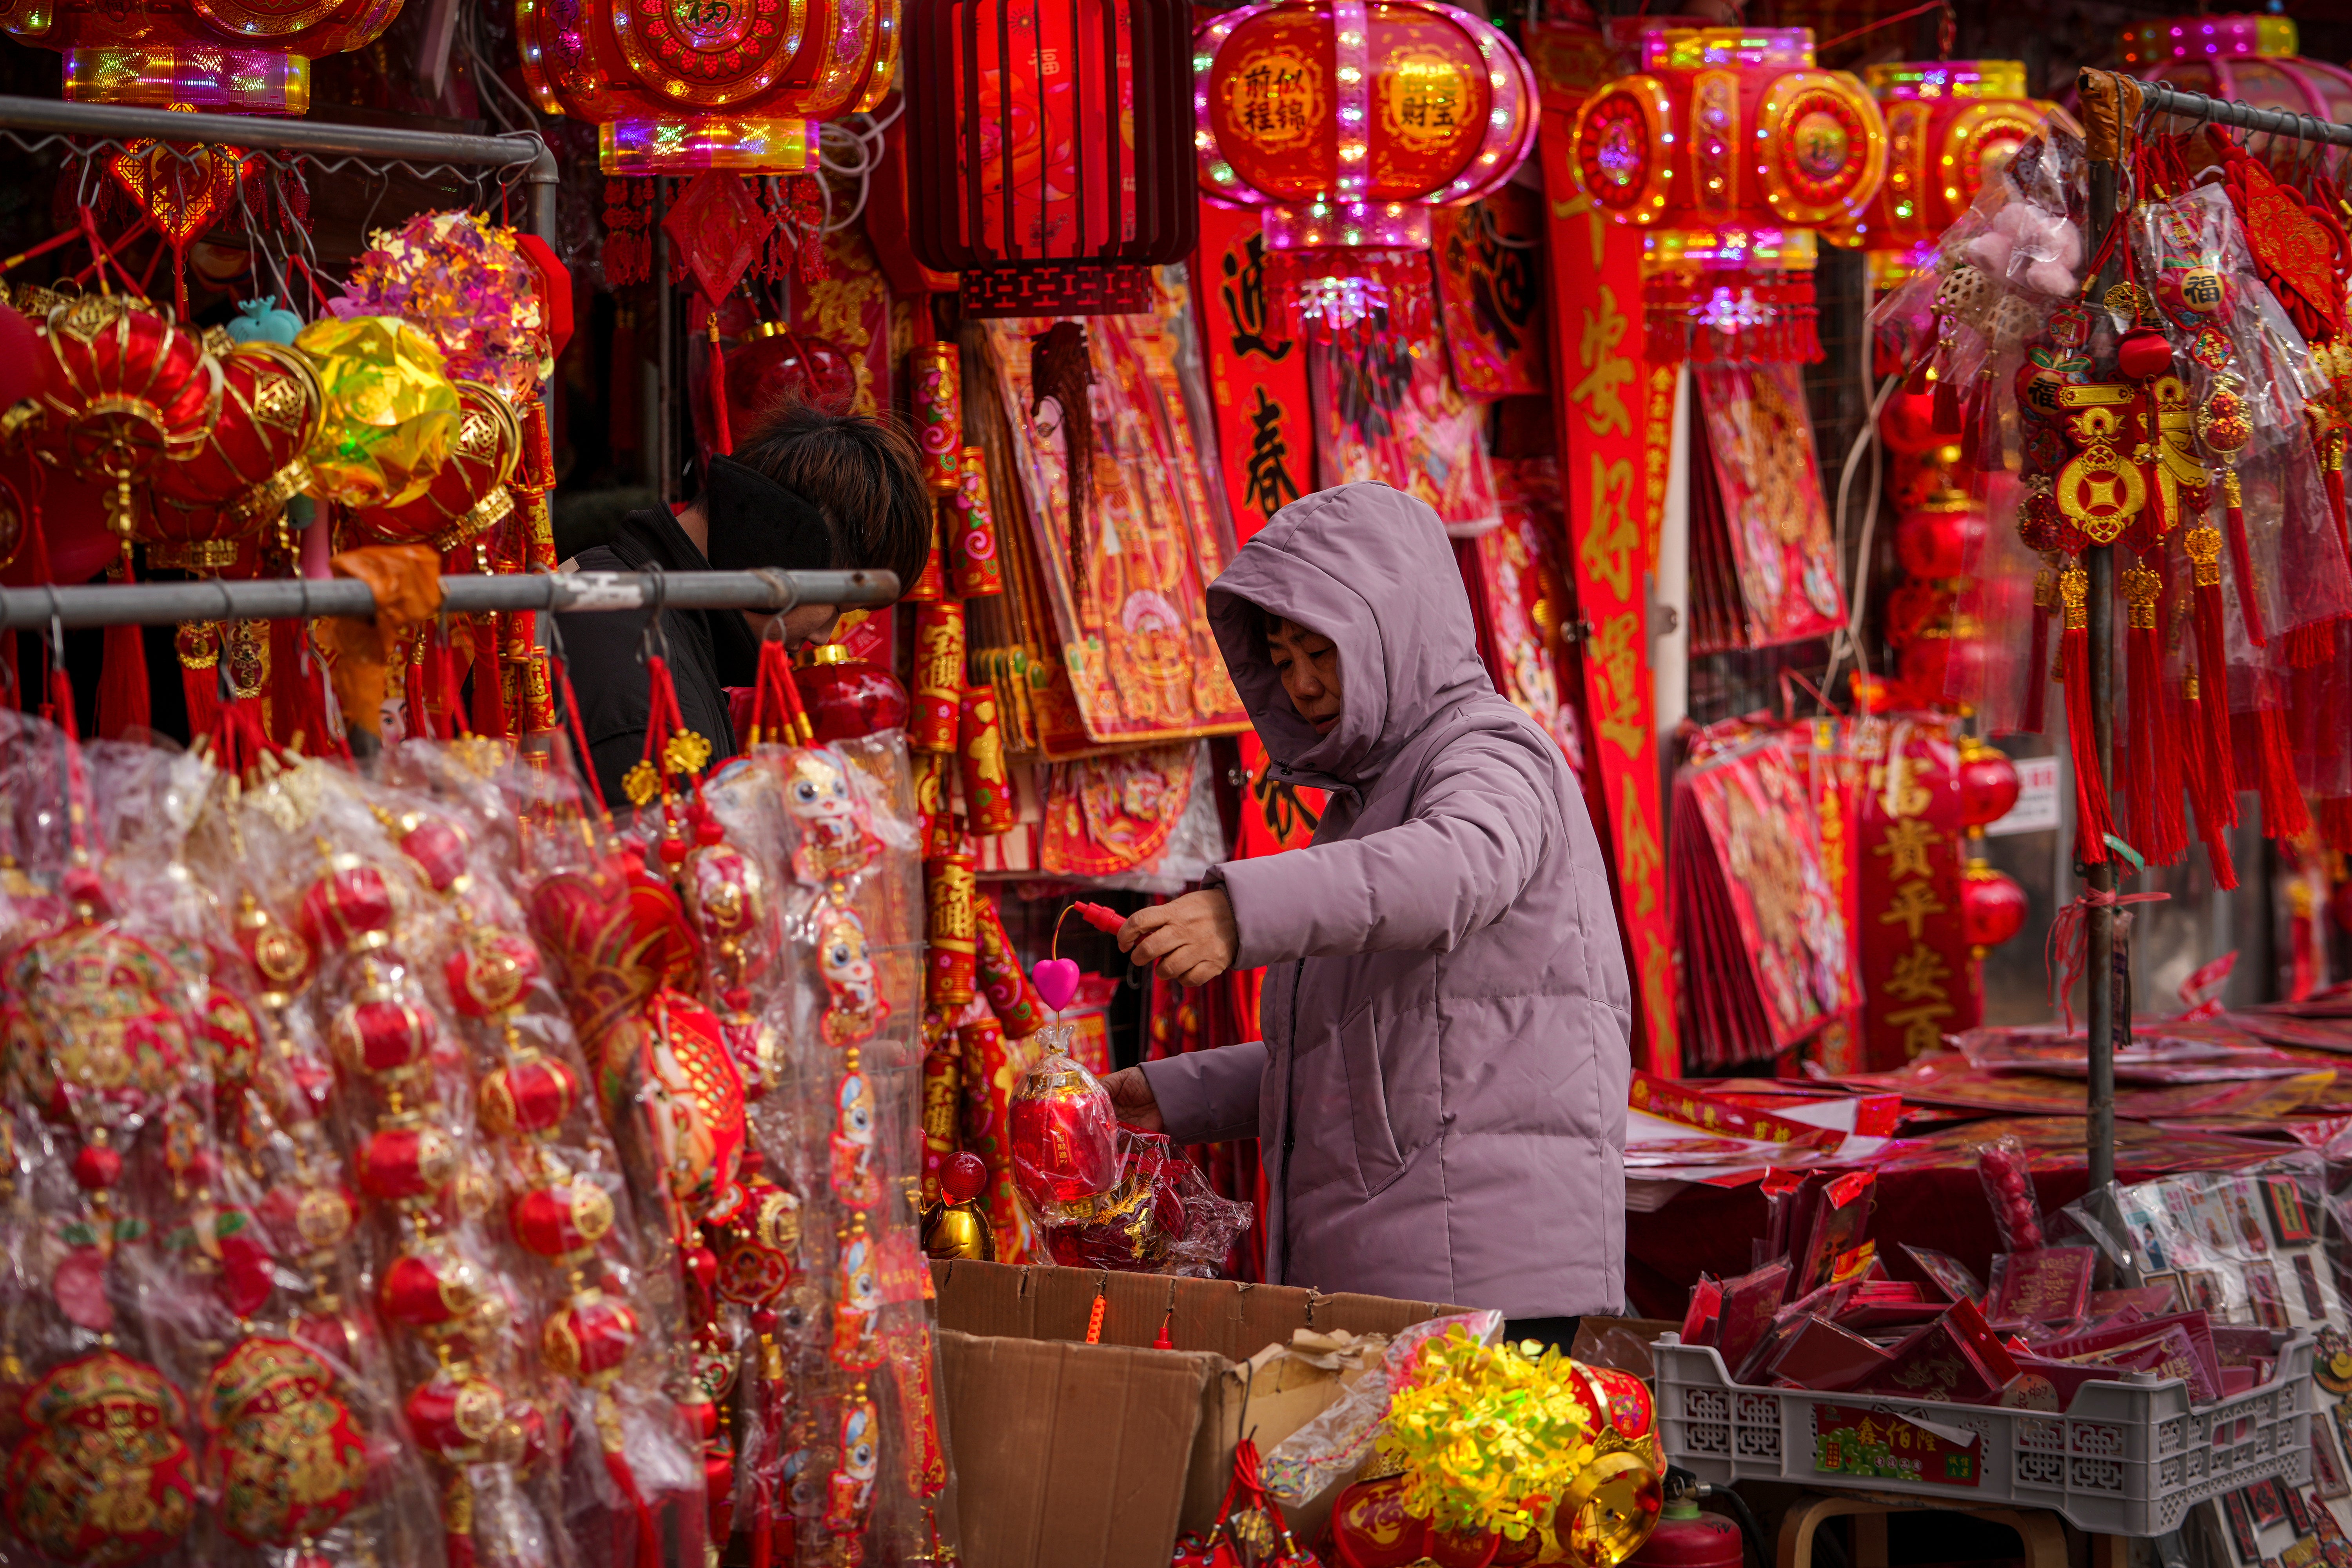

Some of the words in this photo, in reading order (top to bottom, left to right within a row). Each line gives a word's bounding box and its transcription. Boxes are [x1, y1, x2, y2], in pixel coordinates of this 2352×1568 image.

[1027, 48, 1060, 79] 福
[2183, 275, 2220, 304] 福
[2028, 377, 2061, 410] 福
[1056, 1135, 1068, 1165] 招財進
